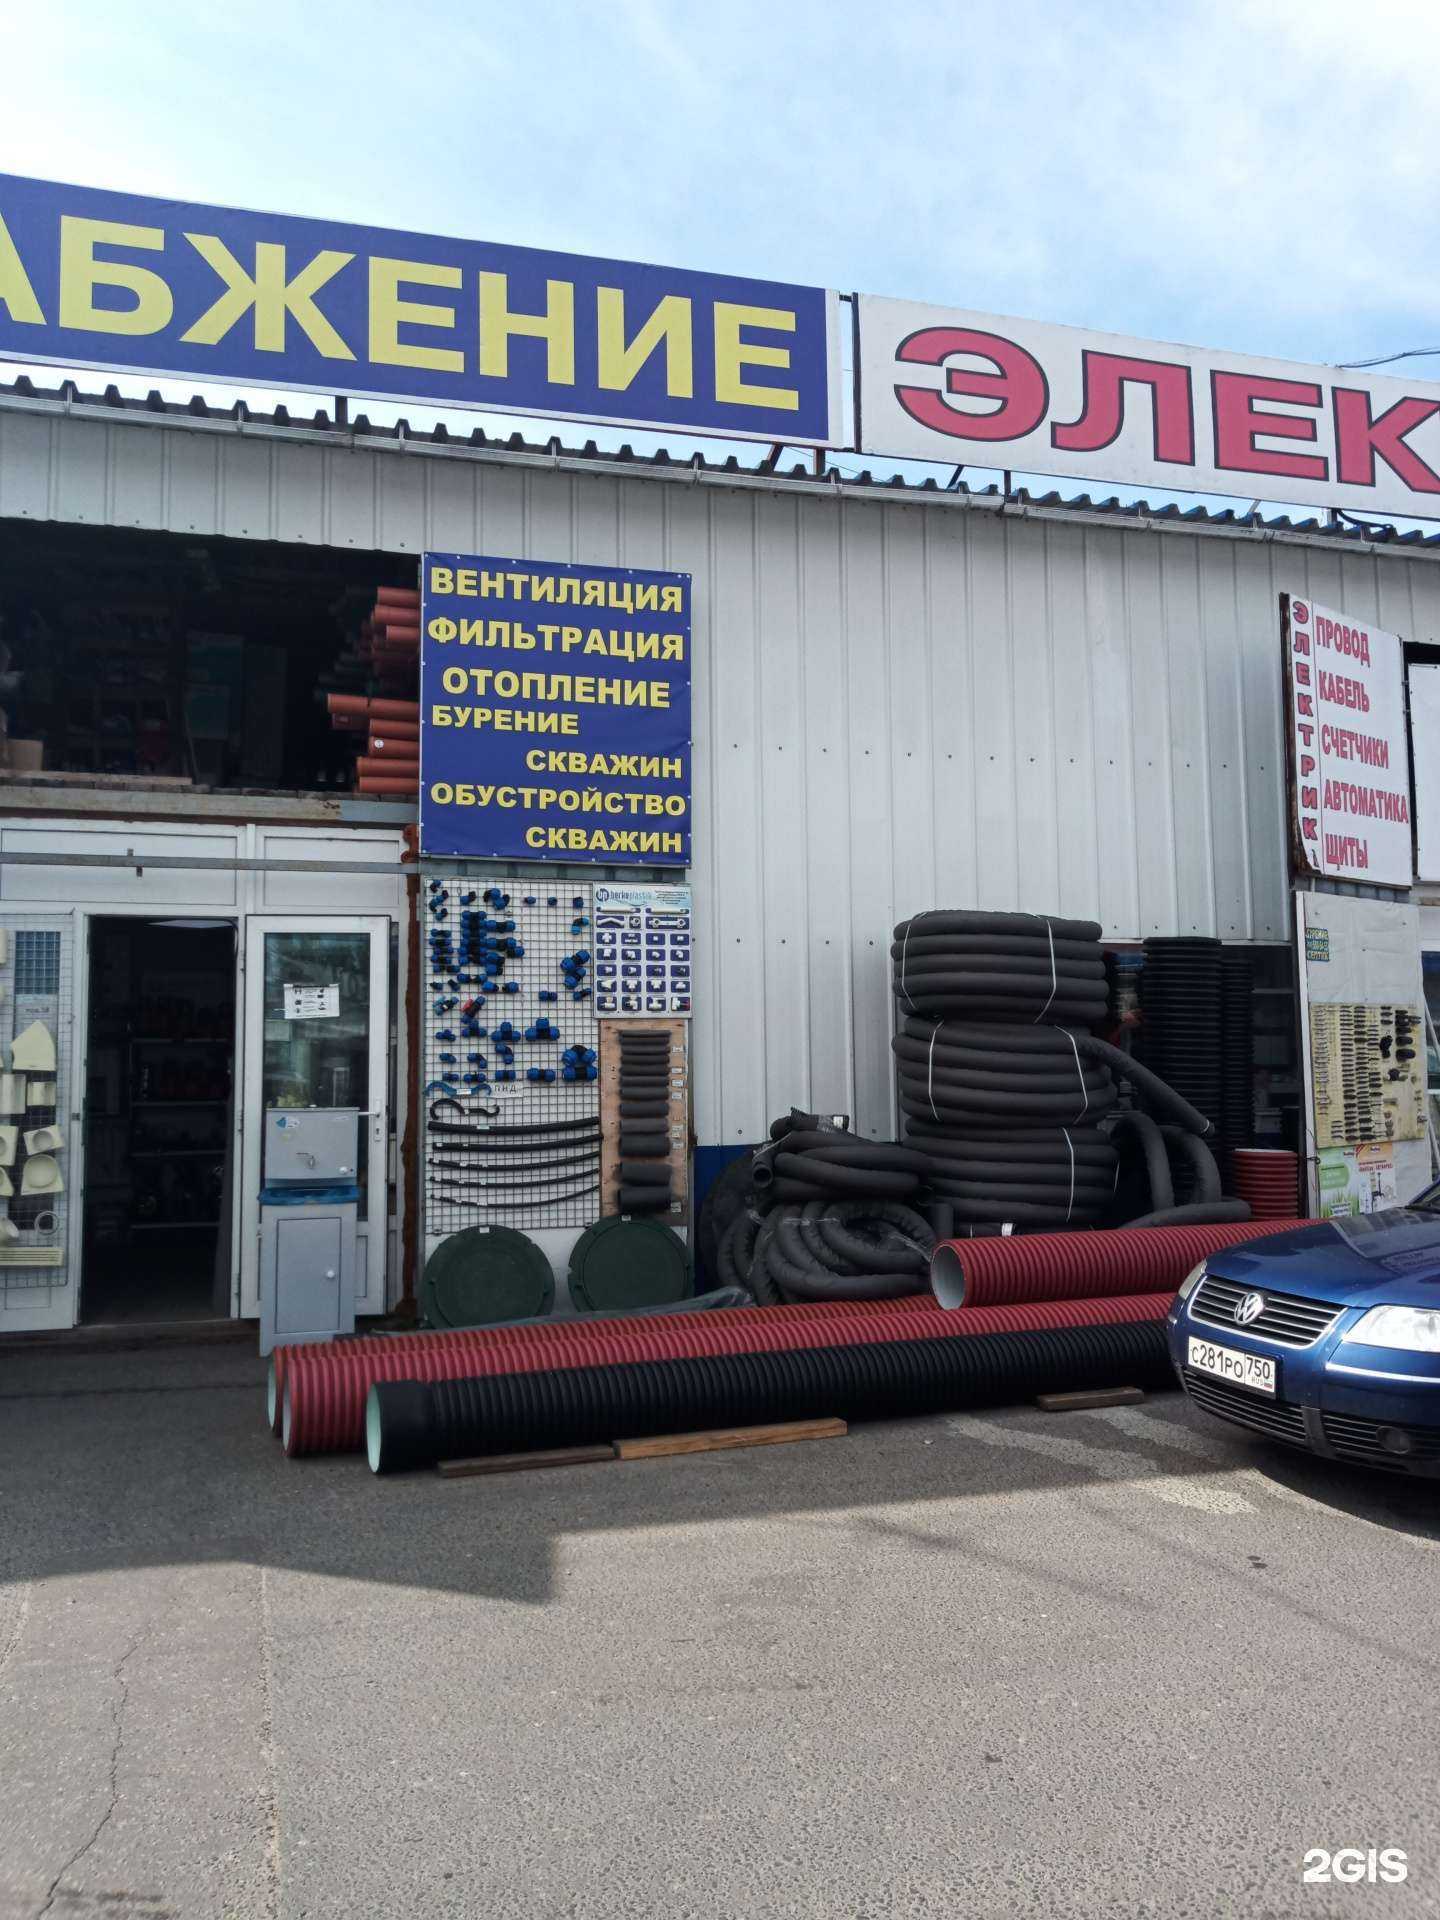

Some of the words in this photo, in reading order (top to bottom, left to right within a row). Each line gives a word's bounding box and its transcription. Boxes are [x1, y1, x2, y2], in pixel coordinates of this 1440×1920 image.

[893, 326, 1440, 493] ЭЛЕК
[430, 566, 683, 614] ВЕНТИЛЯЦИЯ
[428, 617, 684, 662] ФИЛЬТРАЦИЯ
[1315, 615, 1371, 668] ПРОВОД
[442, 667, 671, 708] ОТОПЛЕНИЕ
[1318, 670, 1370, 713] КАБЕЛЬ
[431, 705, 580, 735] БУРЕНИЕ
[525, 749, 682, 778] СКВАЖИН
[1321, 724, 1389, 769] СЧЕТЧИКИ
[430, 782, 686, 816] ОБУСТРОЙСТВО
[1323, 779, 1409, 824] АВТОМАТИКА
[525, 826, 682, 853] СКВАЖИН
[1325, 833, 1369, 870] ЩИТЫ
[1246, 1357, 1271, 1380] 750
